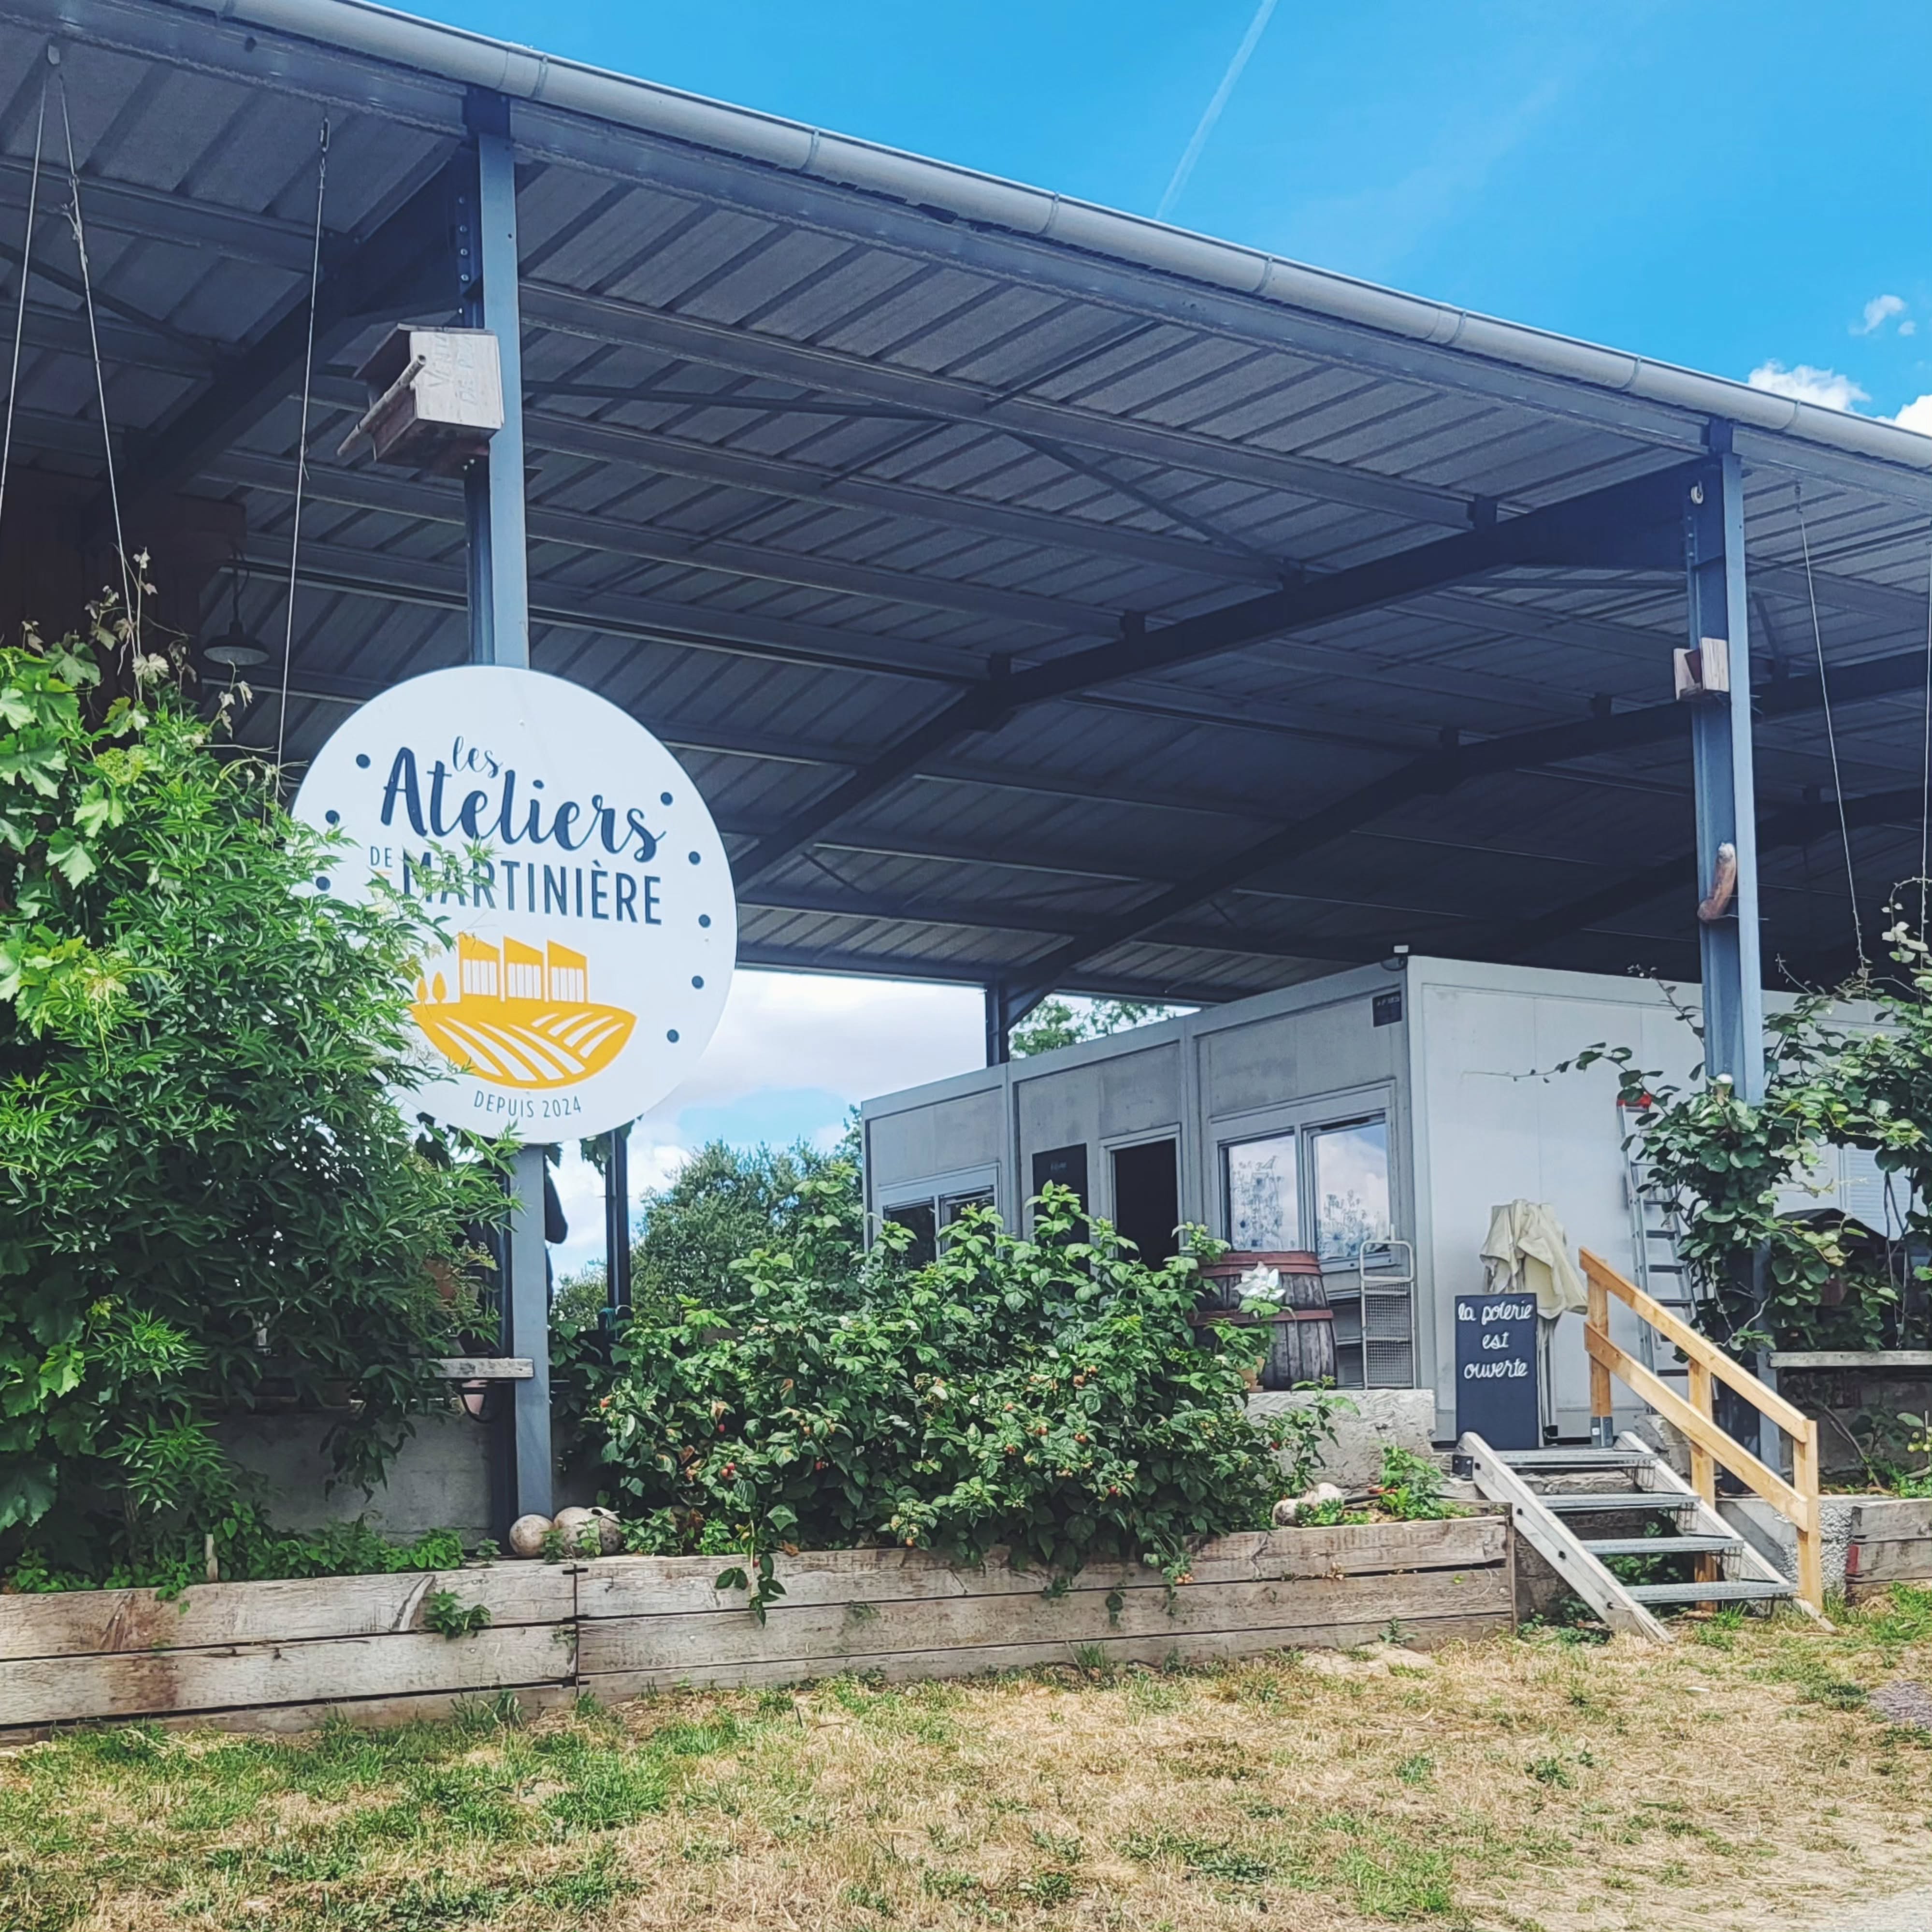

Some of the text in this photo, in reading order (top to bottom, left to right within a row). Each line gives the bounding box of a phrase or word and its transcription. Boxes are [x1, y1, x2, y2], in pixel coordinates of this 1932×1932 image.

[453, 736, 502, 779] les
[380, 747, 667, 863] Ateliers
[370, 846, 663, 925] DE MARTINIÈRE
[474, 1090, 582, 1118] DEPUIS 2024
[1457, 1299, 1533, 1326] la poterie
[1482, 1331, 1509, 1350] est
[1463, 1357, 1528, 1379] ouverte
